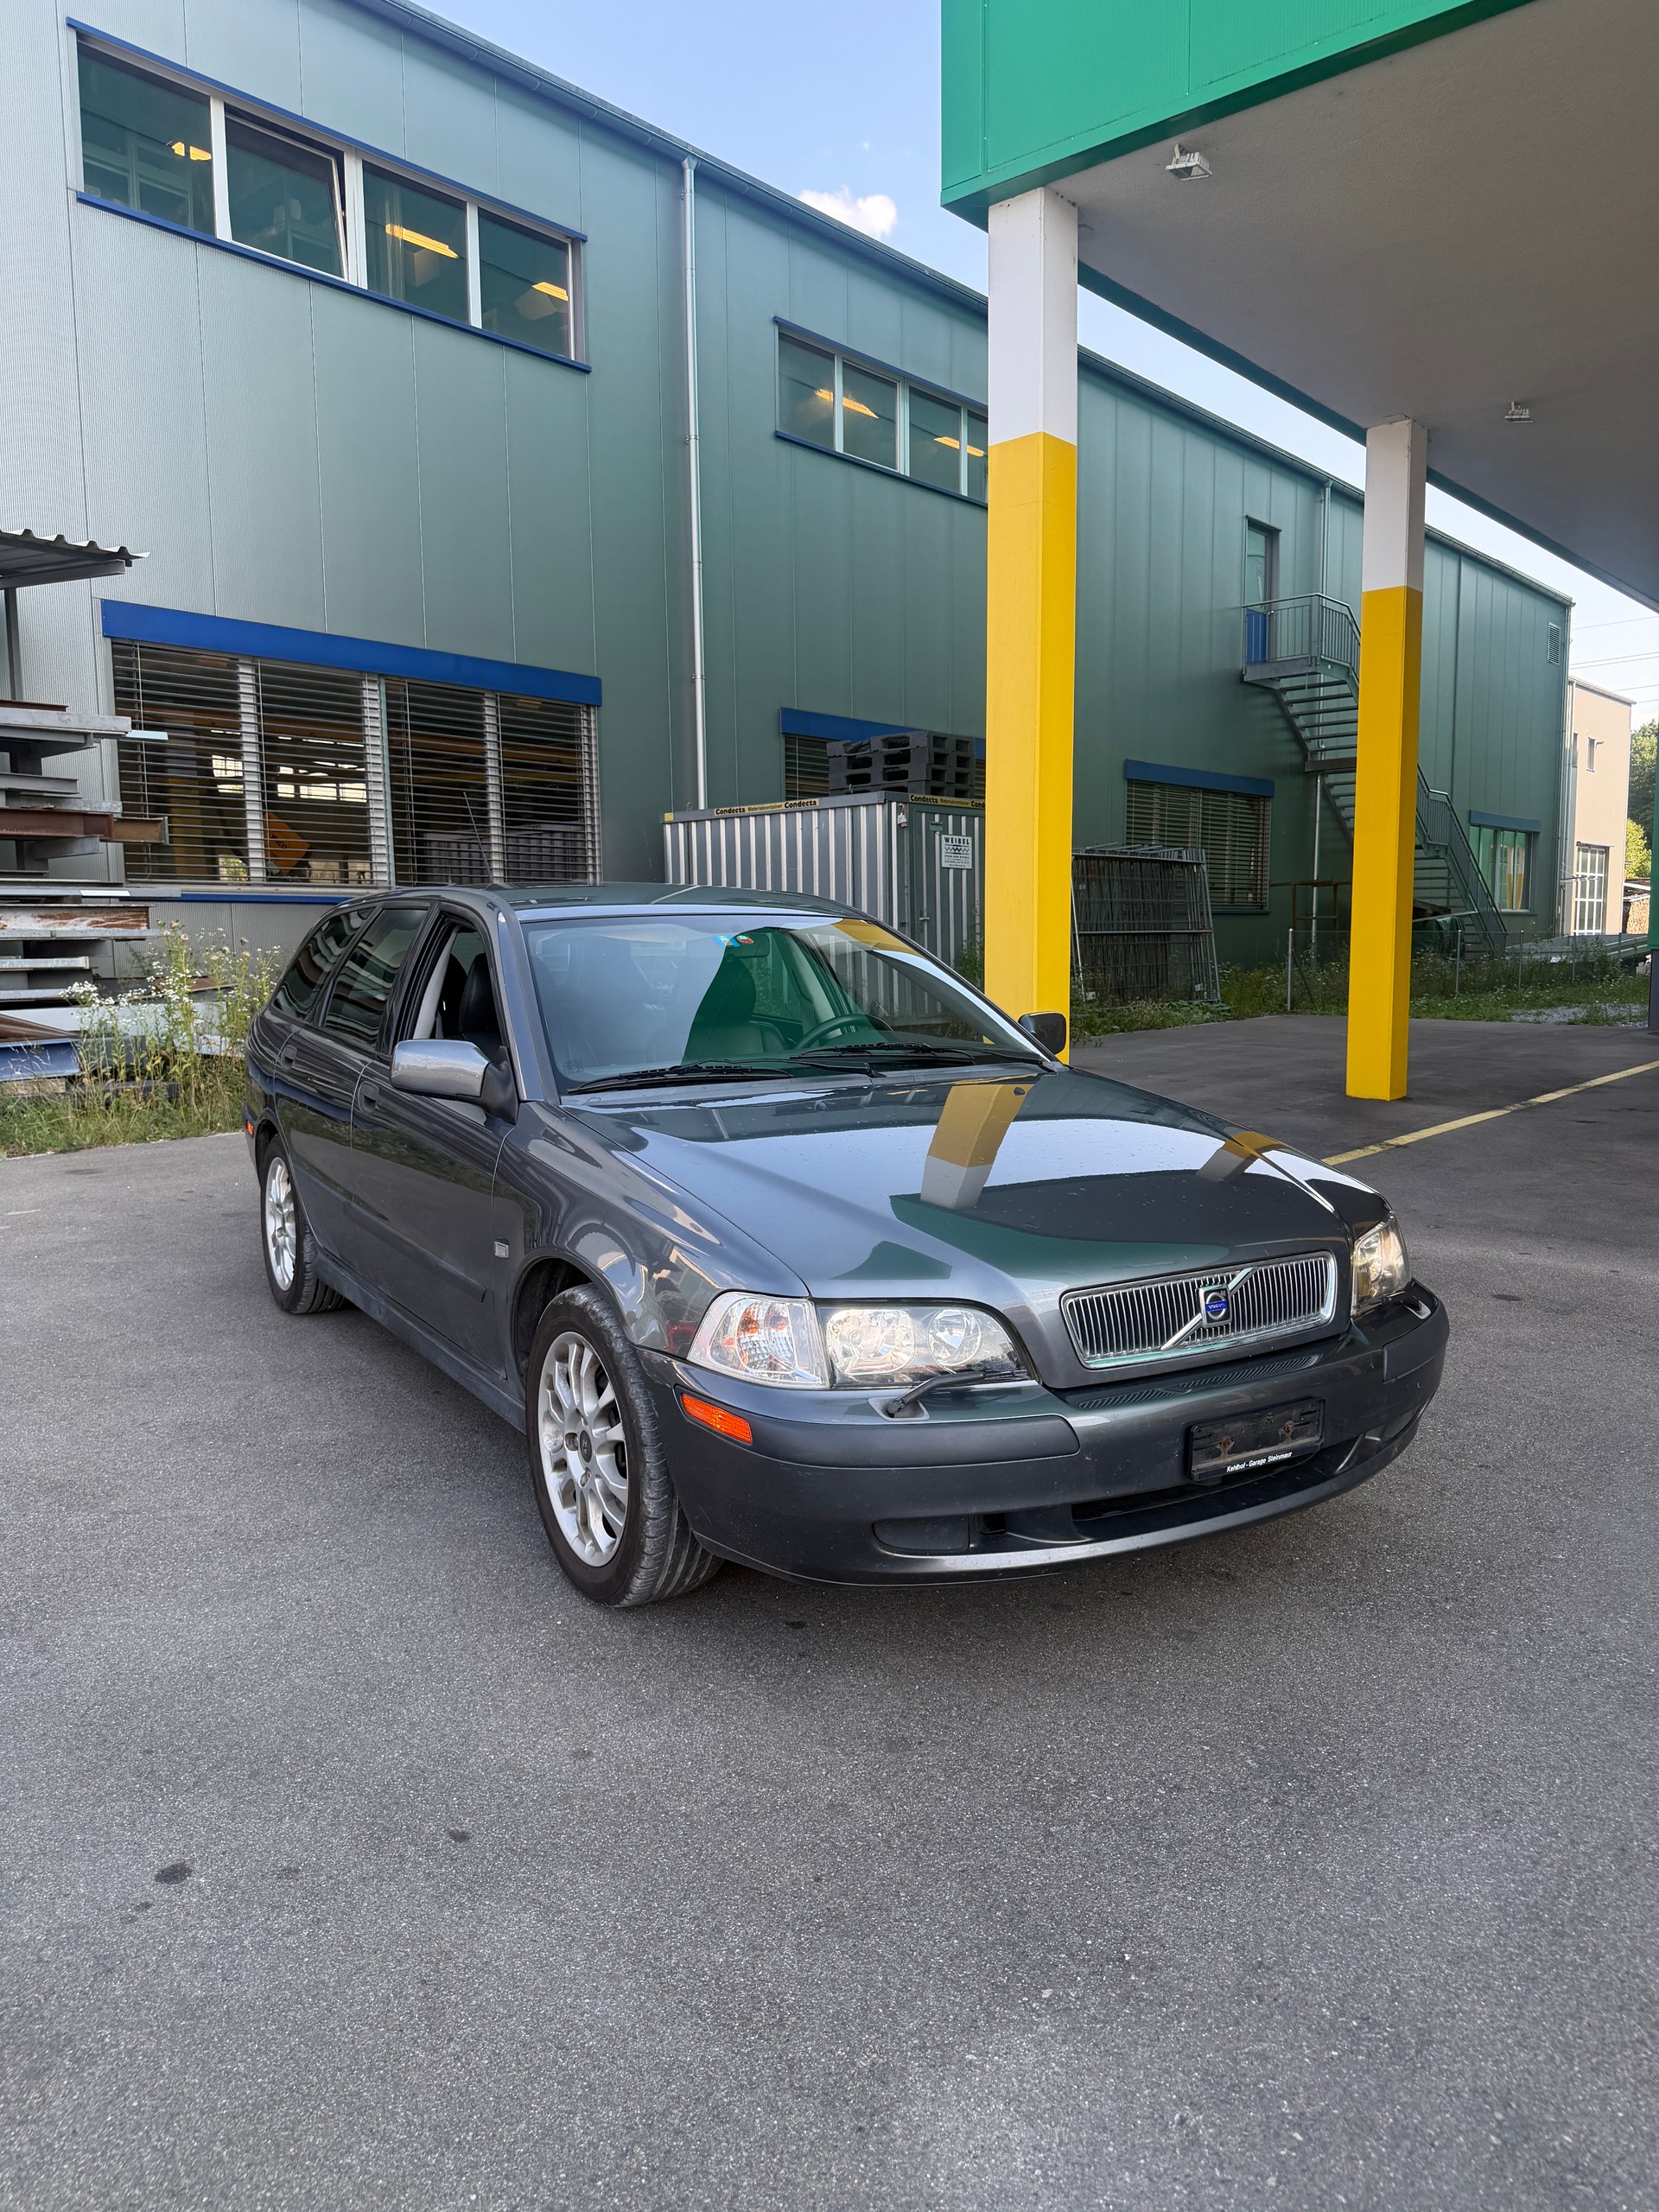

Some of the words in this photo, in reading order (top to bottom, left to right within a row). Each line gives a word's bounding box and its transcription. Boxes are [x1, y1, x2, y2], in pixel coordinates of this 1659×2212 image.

[910, 794, 938, 804] Condecta
[784, 799, 817, 809] Condecta
[944, 836, 969, 845] WEIBEL
[1249, 1458, 1267, 1467] Garage
